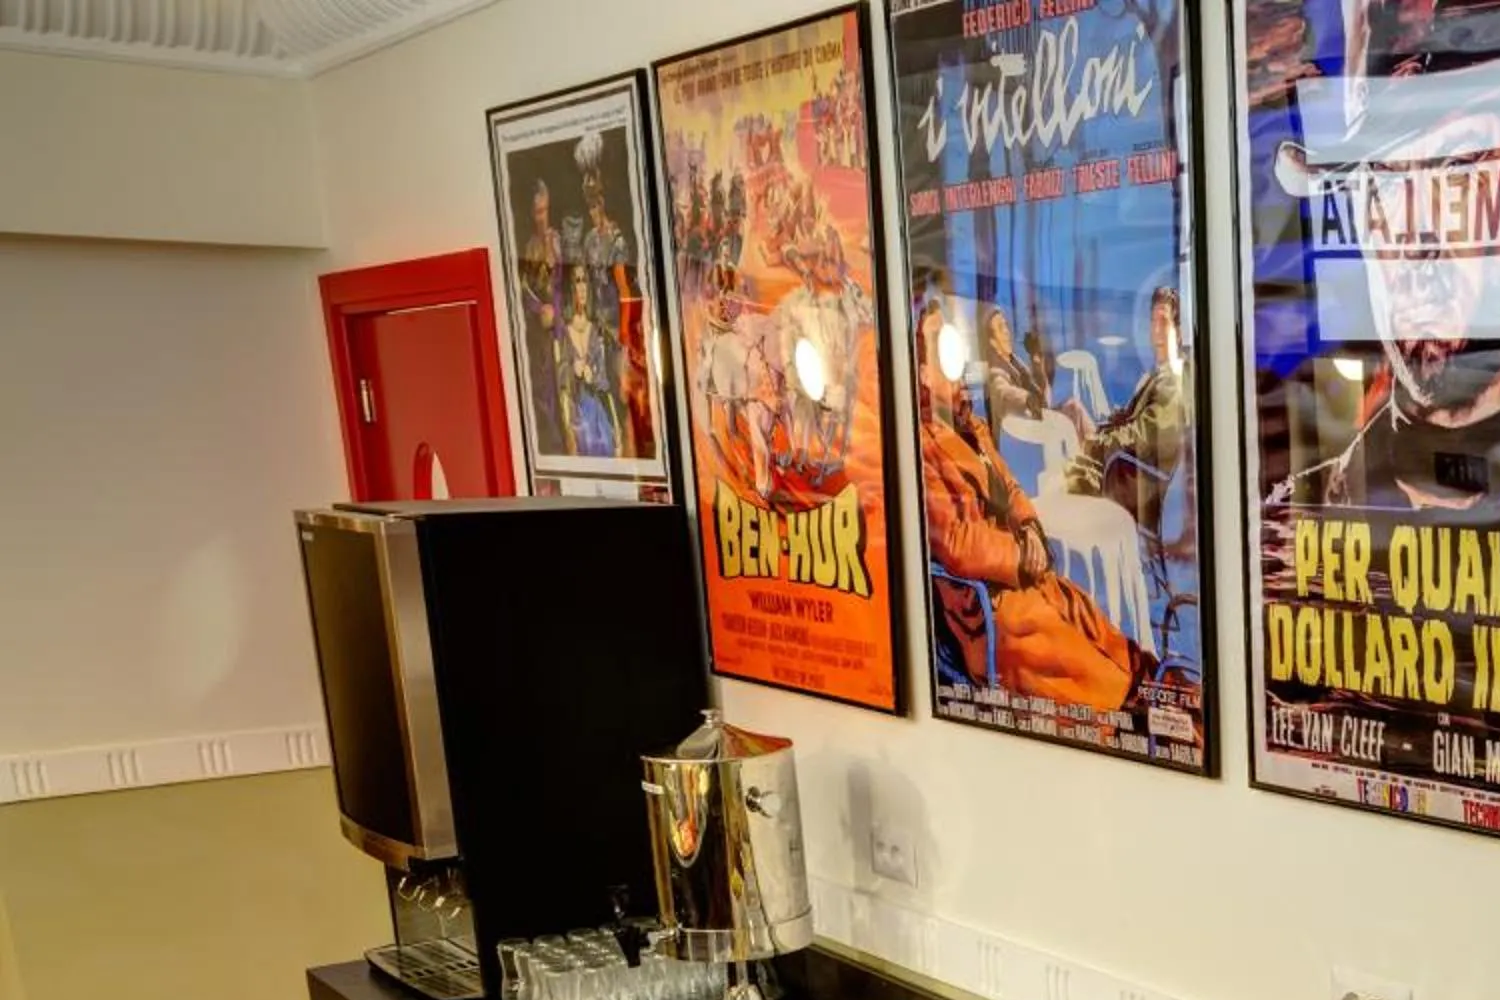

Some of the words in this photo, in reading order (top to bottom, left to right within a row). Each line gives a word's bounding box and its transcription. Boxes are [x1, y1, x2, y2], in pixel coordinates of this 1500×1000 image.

[962, 3, 1031, 39] FEDERICO
[1073, 160, 1120, 193] TRIESTE
[1127, 150, 1177, 185] FELLINI
[715, 480, 872, 599] BEN-HUR
[1295, 519, 1374, 605] PER
[794, 598, 834, 623] WYLER
[1268, 602, 1456, 704] DOLLARO
[1272, 704, 1297, 746] LEE
[1302, 708, 1334, 753] VAN
[1340, 715, 1387, 763] CLEEF
[1433, 730, 1475, 780] GIAN
